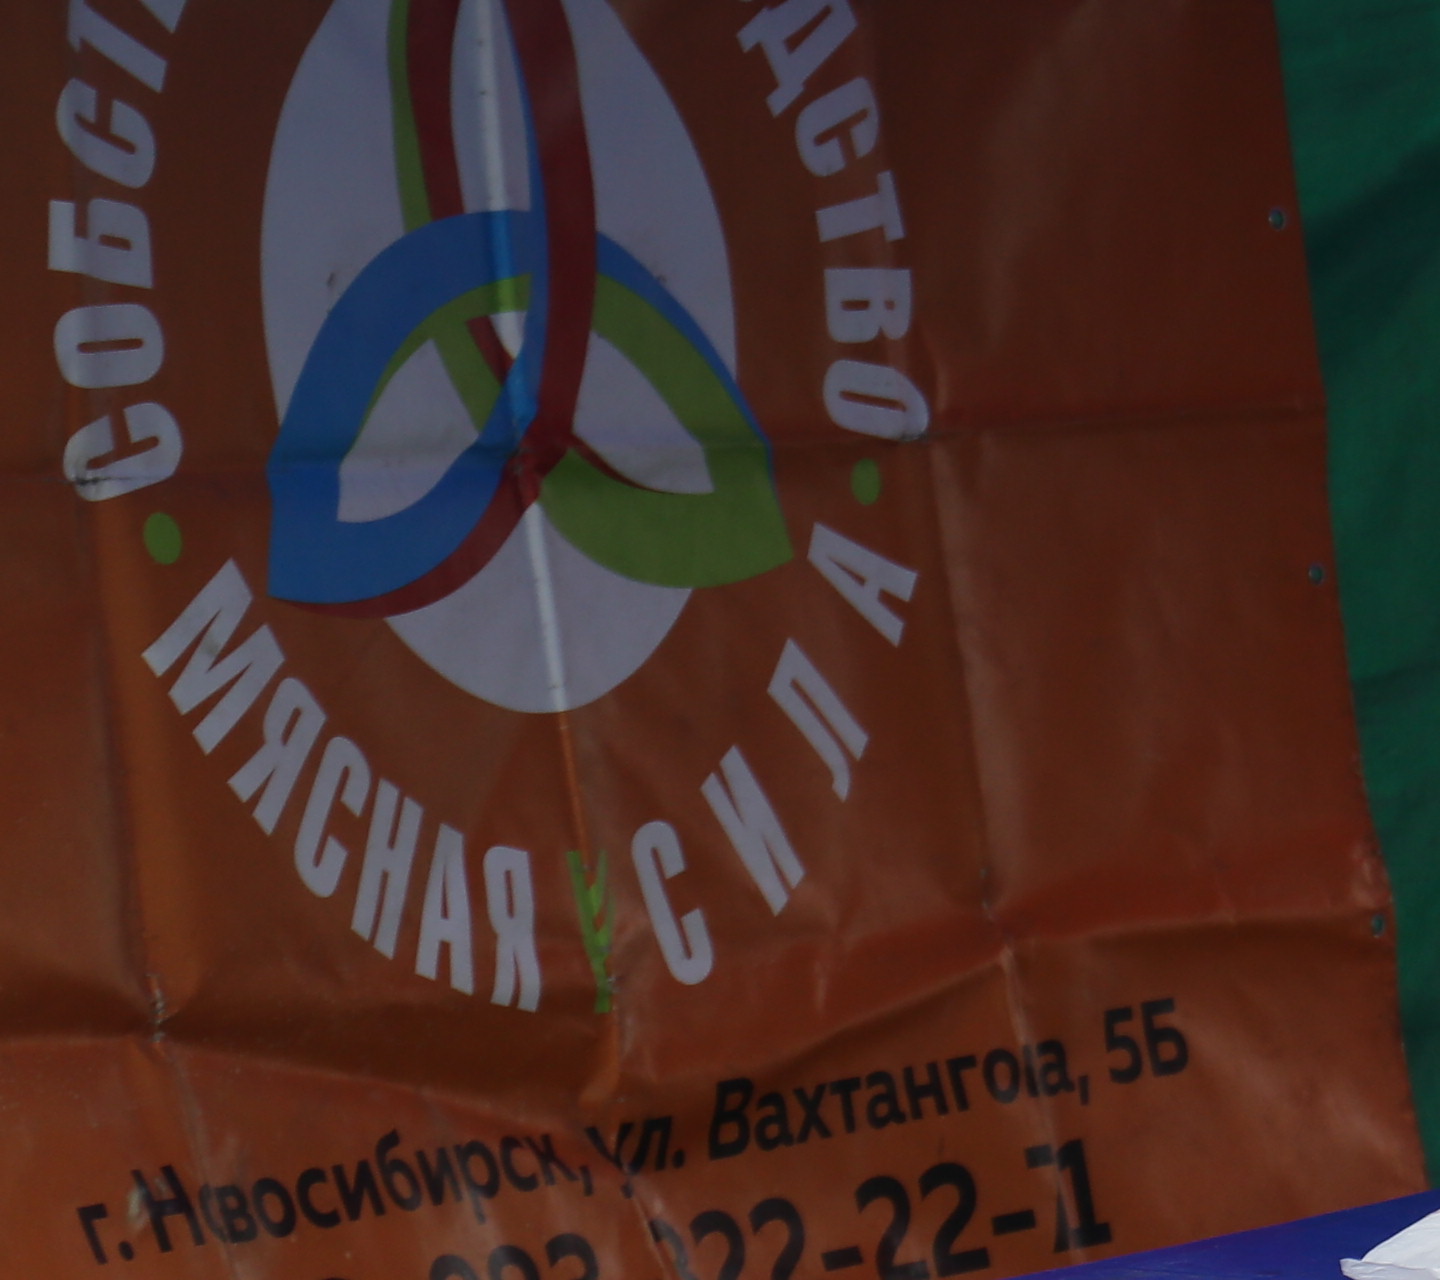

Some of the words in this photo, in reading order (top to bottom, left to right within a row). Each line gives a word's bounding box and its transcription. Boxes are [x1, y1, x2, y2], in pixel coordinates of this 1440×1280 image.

[141, 558, 541, 1012] МЯСНАЯ
[631, 523, 918, 985] СИЛА
[77, 1203, 134, 1261] г.
[1103, 998, 1189, 1084] 5Б
